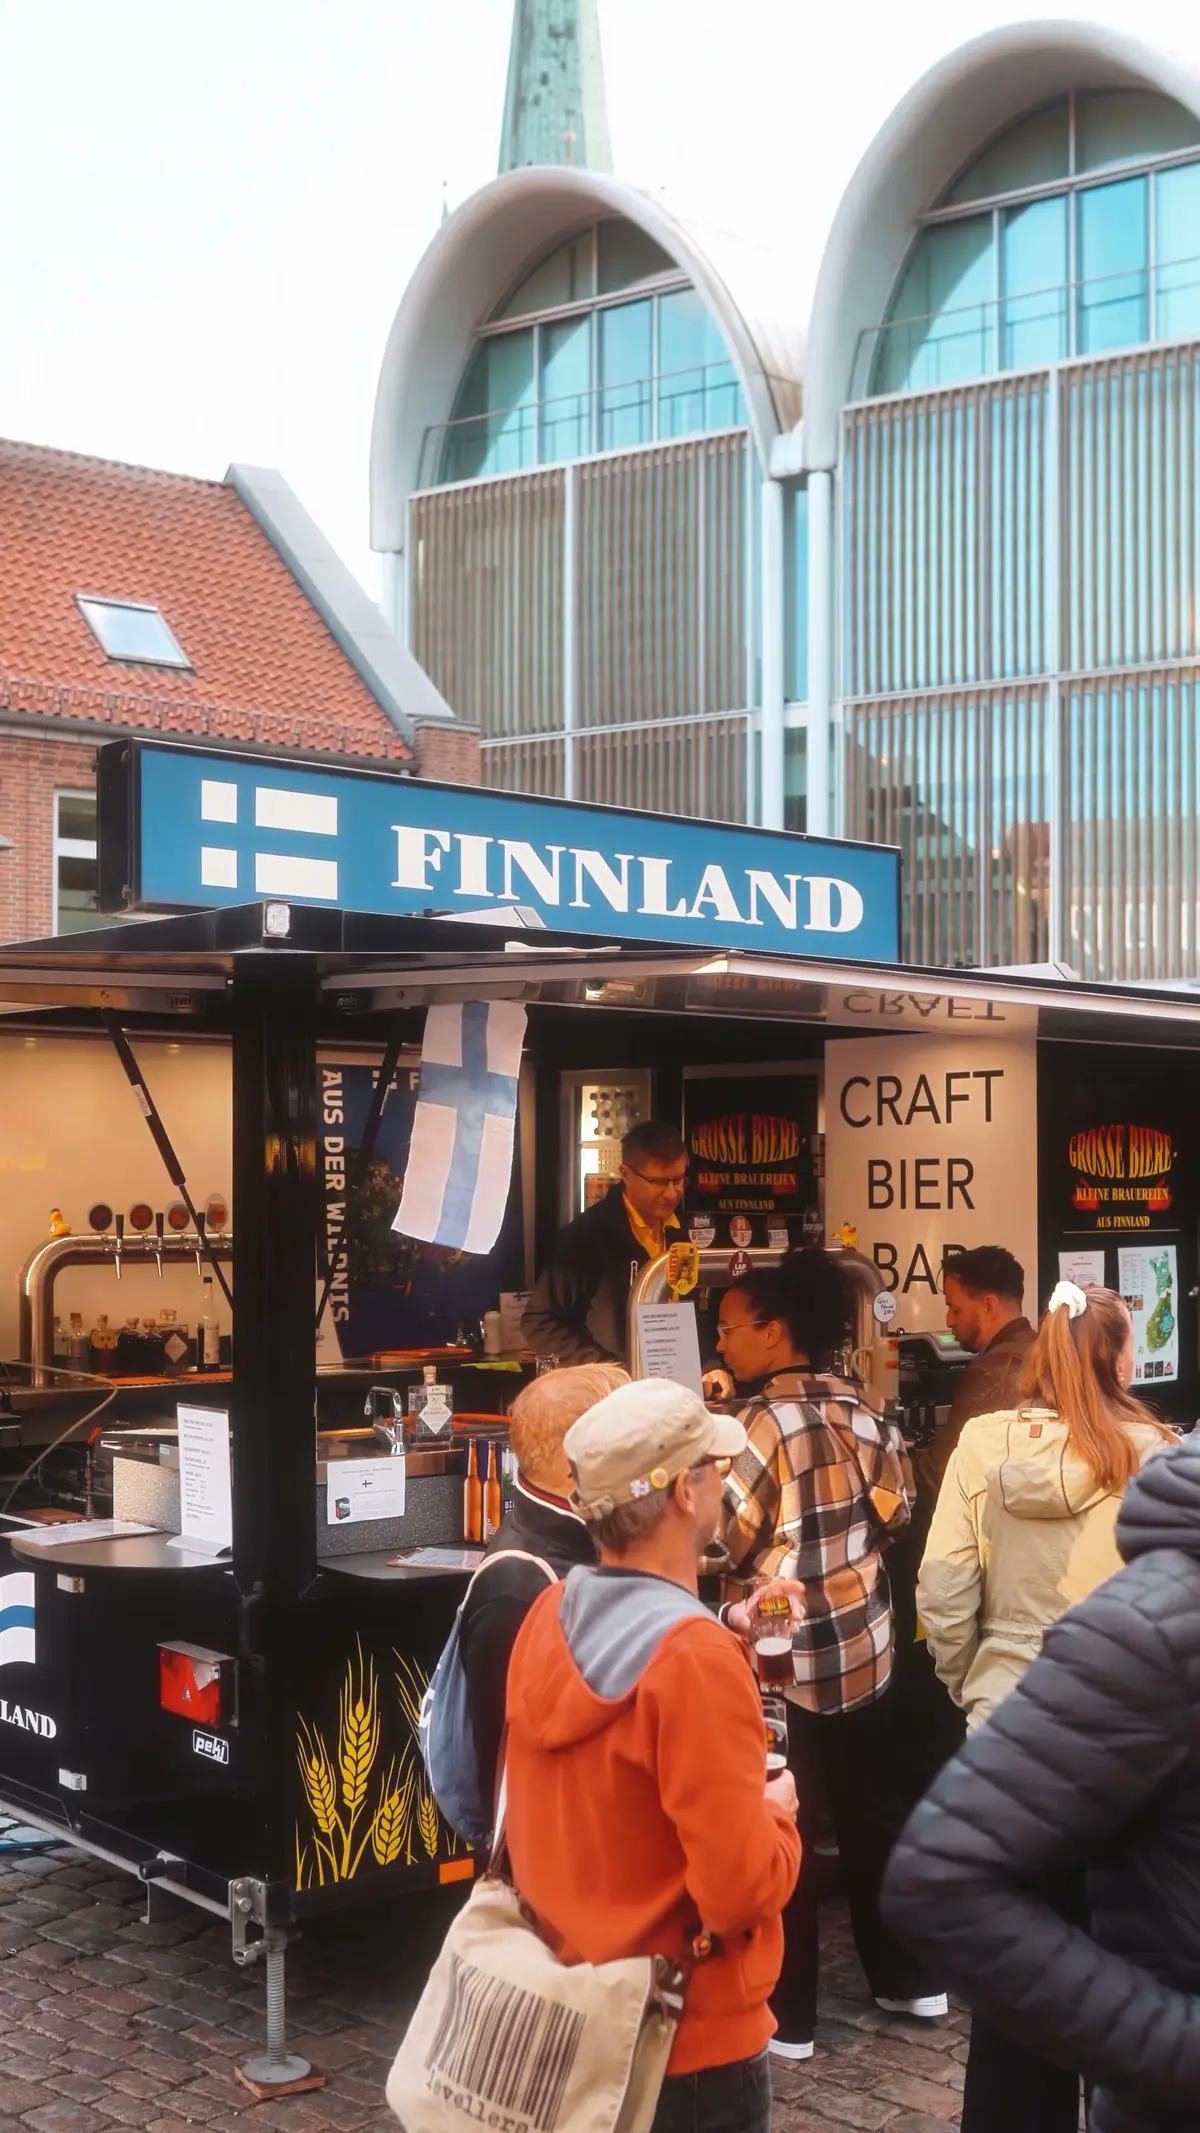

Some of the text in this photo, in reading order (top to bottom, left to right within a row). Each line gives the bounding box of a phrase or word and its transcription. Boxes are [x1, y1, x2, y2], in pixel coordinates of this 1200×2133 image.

[390, 825, 864, 933] FINNLAND
[322, 1070, 344, 1124] AUS
[840, 1070, 1004, 1128] CRAFT
[324, 1136, 346, 1190] DER
[691, 1114, 747, 1164] GROSSE
[1068, 1124, 1125, 1179] GROSSE
[698, 1172, 797, 1186] KLEINE BRAUEREIEN
[718, 1199, 775, 1210] AUS FINNLAND
[868, 1158, 975, 1209] BIER
[1076, 1187, 1169, 1201] KLEINE BRAUEREIEN
[1096, 1215, 1150, 1228] AUS FINNLAND
[195, 1736, 226, 1761] peki
[426, 2068, 530, 2133] levellers
